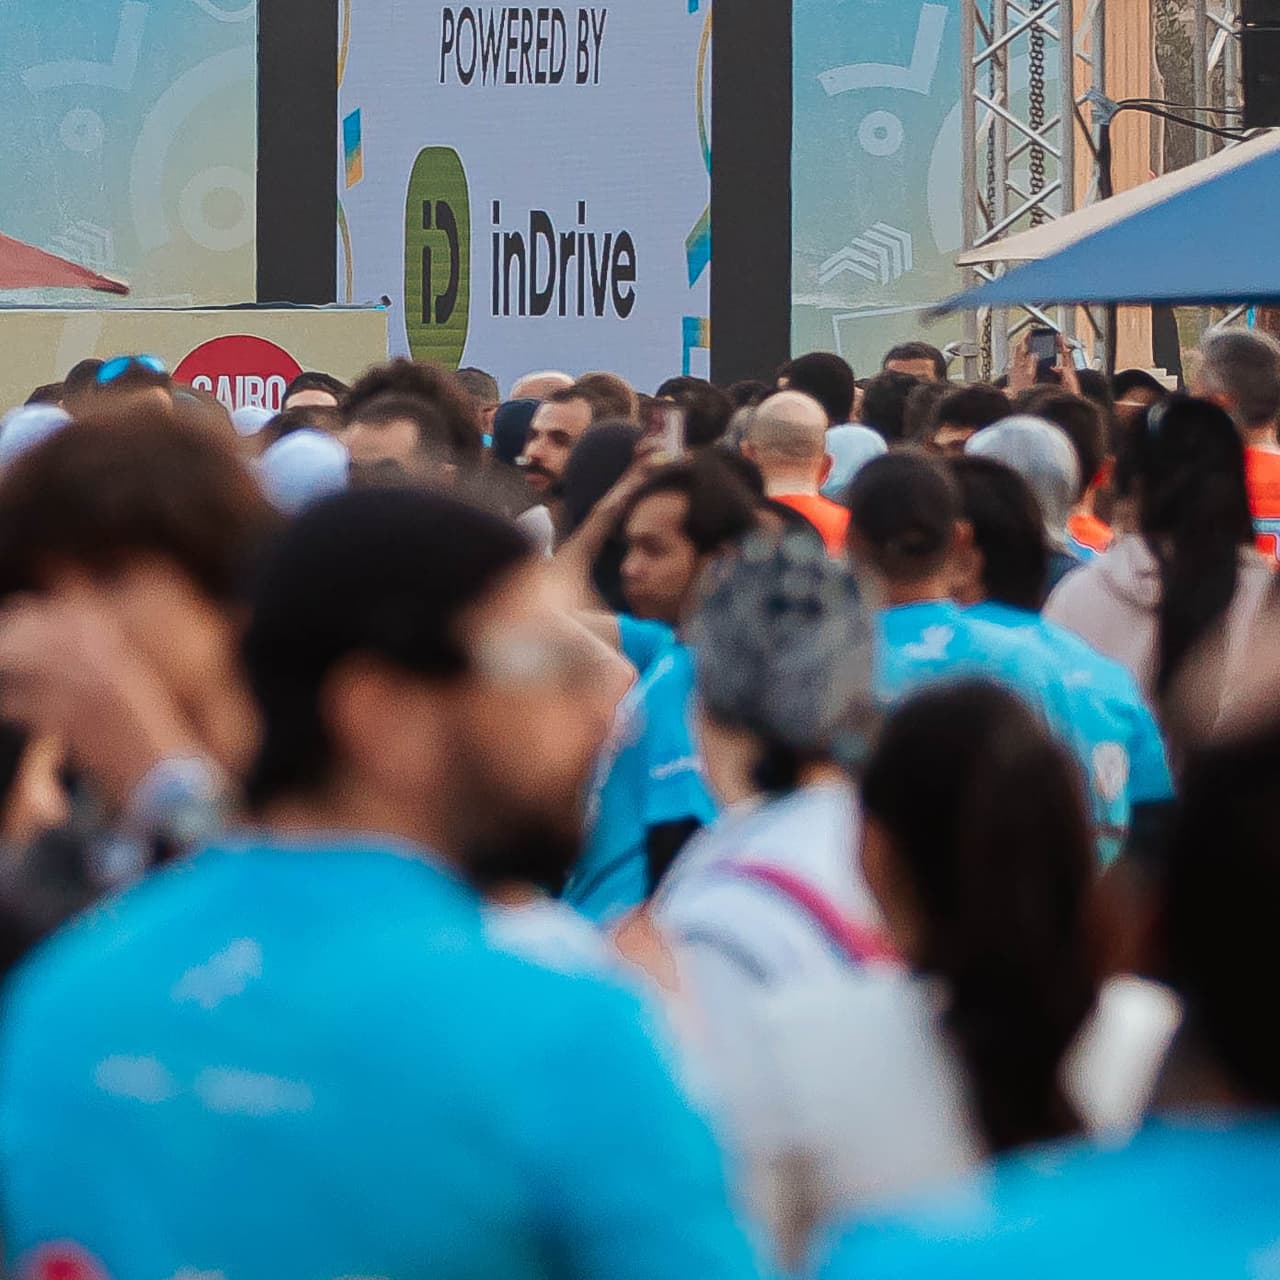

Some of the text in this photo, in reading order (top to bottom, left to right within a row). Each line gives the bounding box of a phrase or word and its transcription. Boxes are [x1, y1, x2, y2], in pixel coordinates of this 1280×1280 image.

[439, 6, 607, 86] POWERED BY
[492, 200, 637, 319] inDrive
